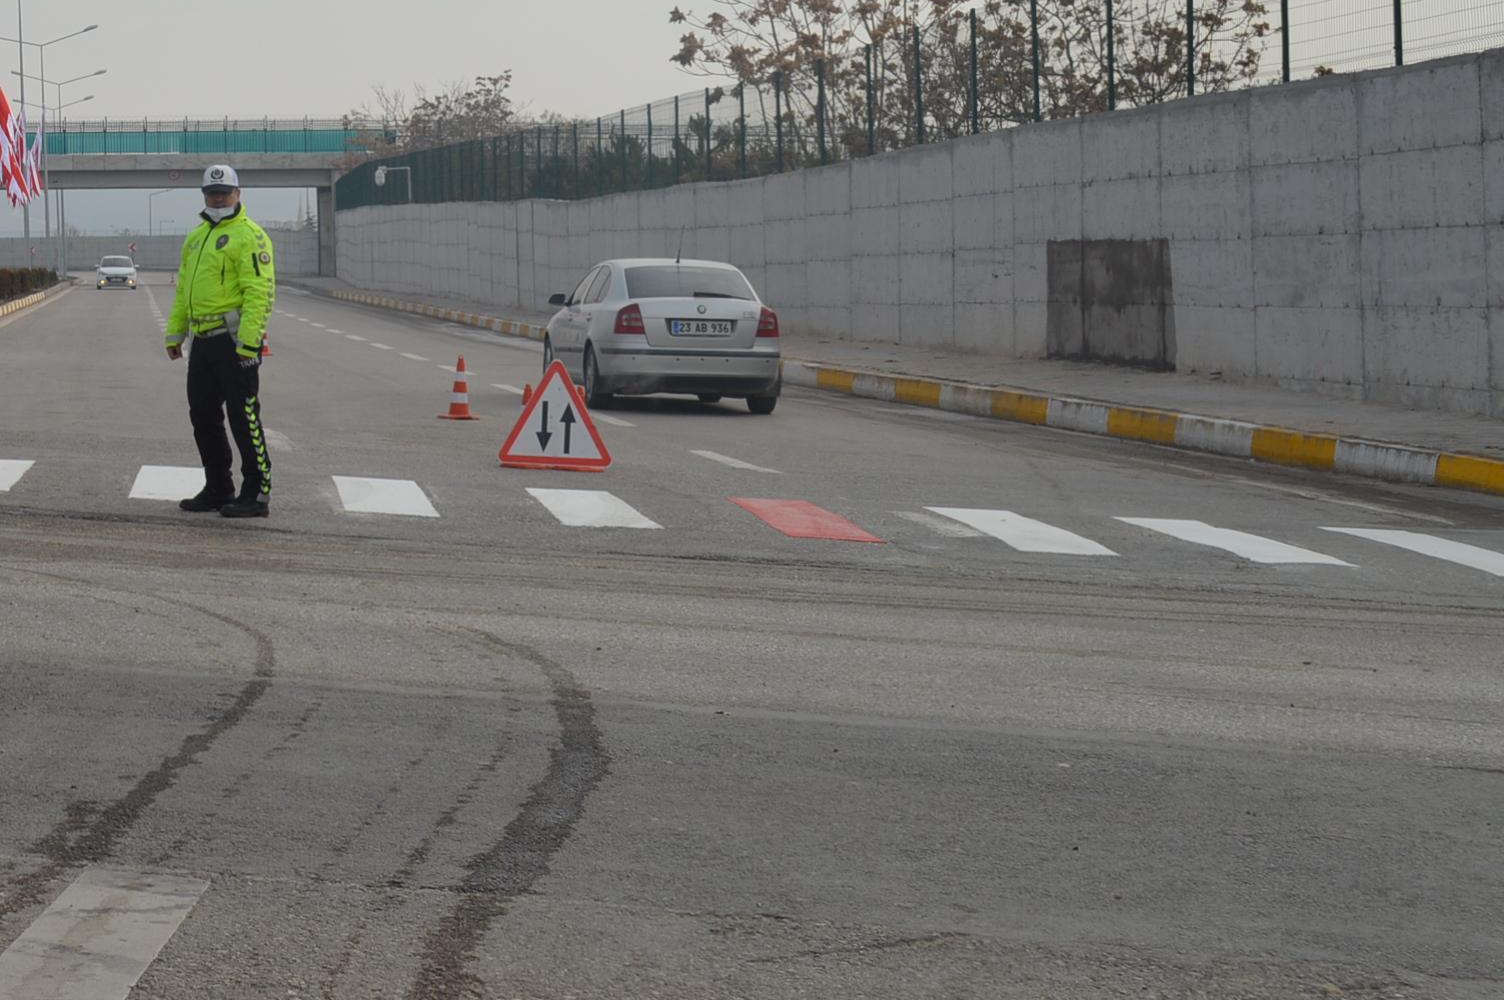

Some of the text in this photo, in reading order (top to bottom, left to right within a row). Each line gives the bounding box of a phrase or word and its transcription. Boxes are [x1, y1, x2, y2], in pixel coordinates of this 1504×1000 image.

[680, 323, 729, 333] 23 AB 936
